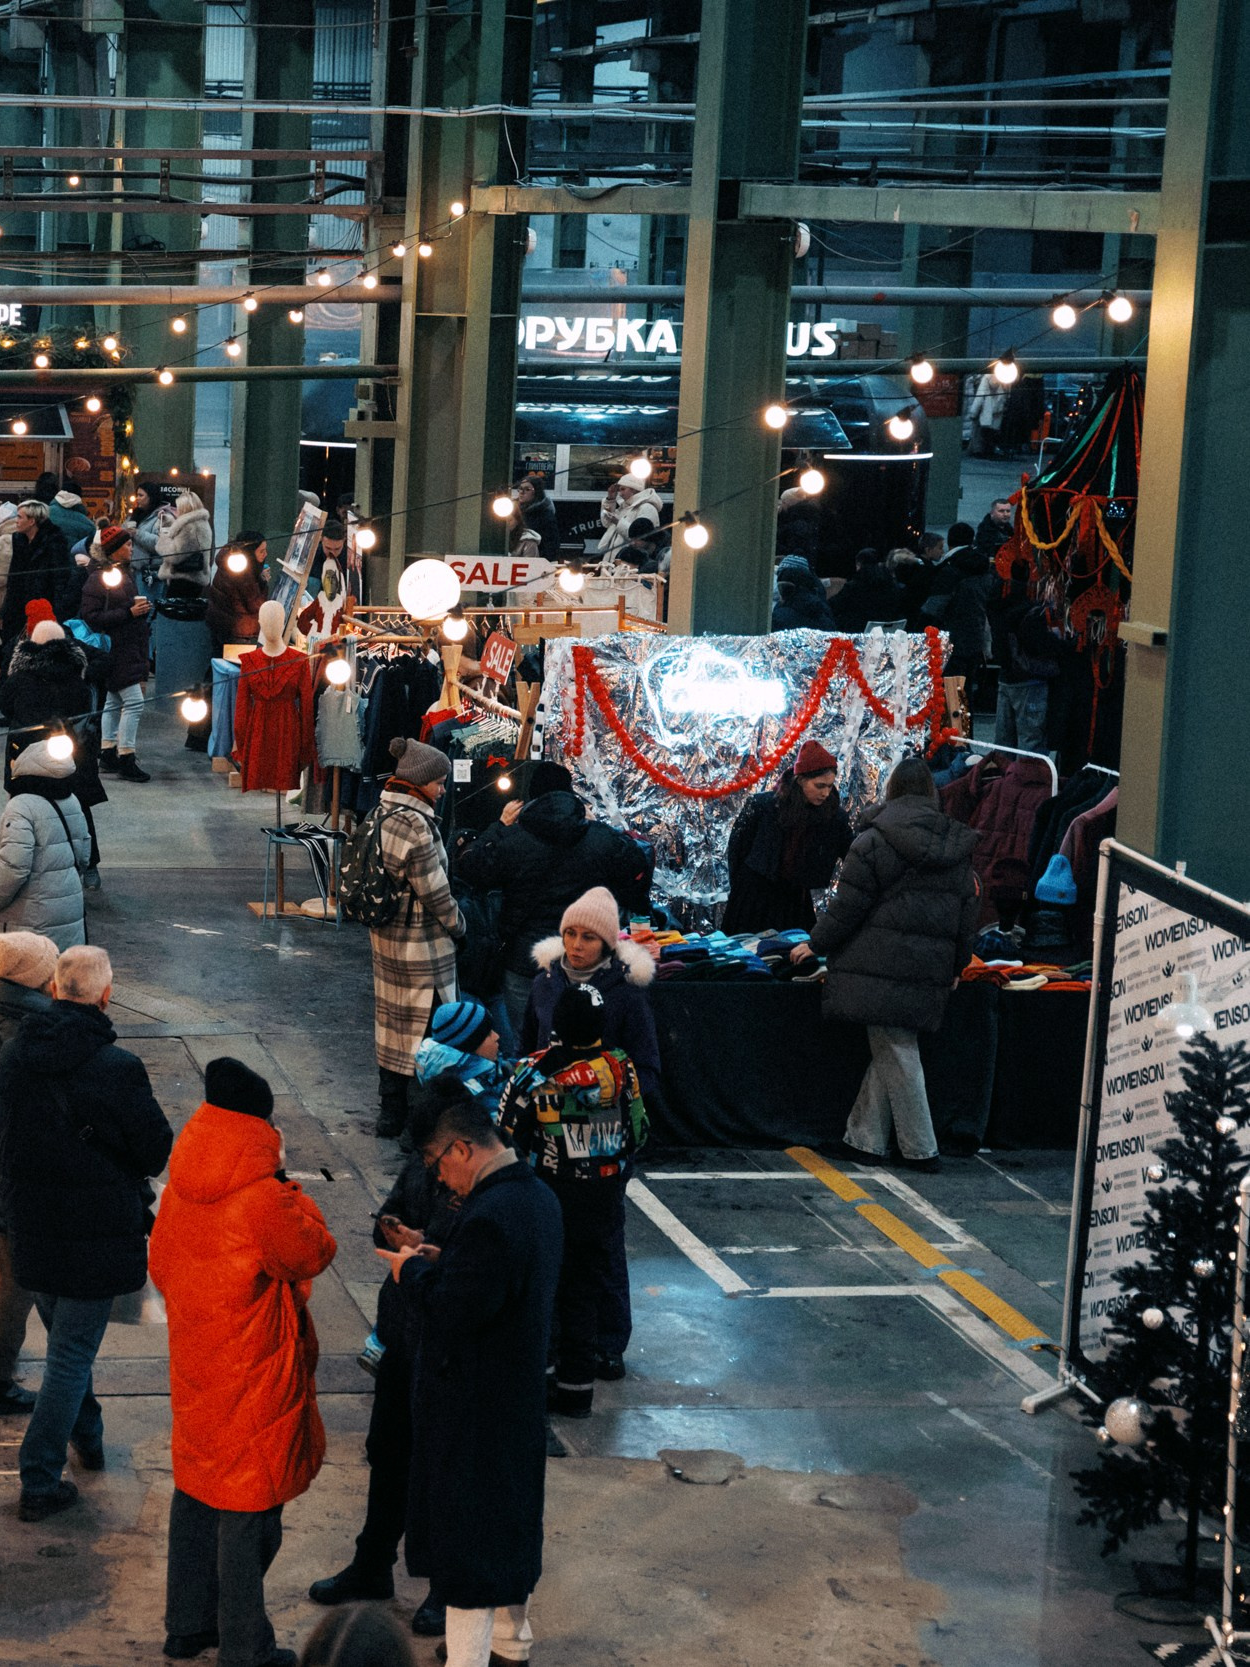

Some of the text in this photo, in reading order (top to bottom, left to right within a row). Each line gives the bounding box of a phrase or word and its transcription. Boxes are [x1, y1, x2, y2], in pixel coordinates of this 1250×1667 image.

[517, 315, 678, 353] РУБКА
[450, 561, 529, 587] SALE
[486, 641, 512, 676] SALE
[1124, 993, 1173, 1026] WOMENS
[1106, 1062, 1165, 1097] WOMENSON
[566, 1121, 622, 1152] RACING
